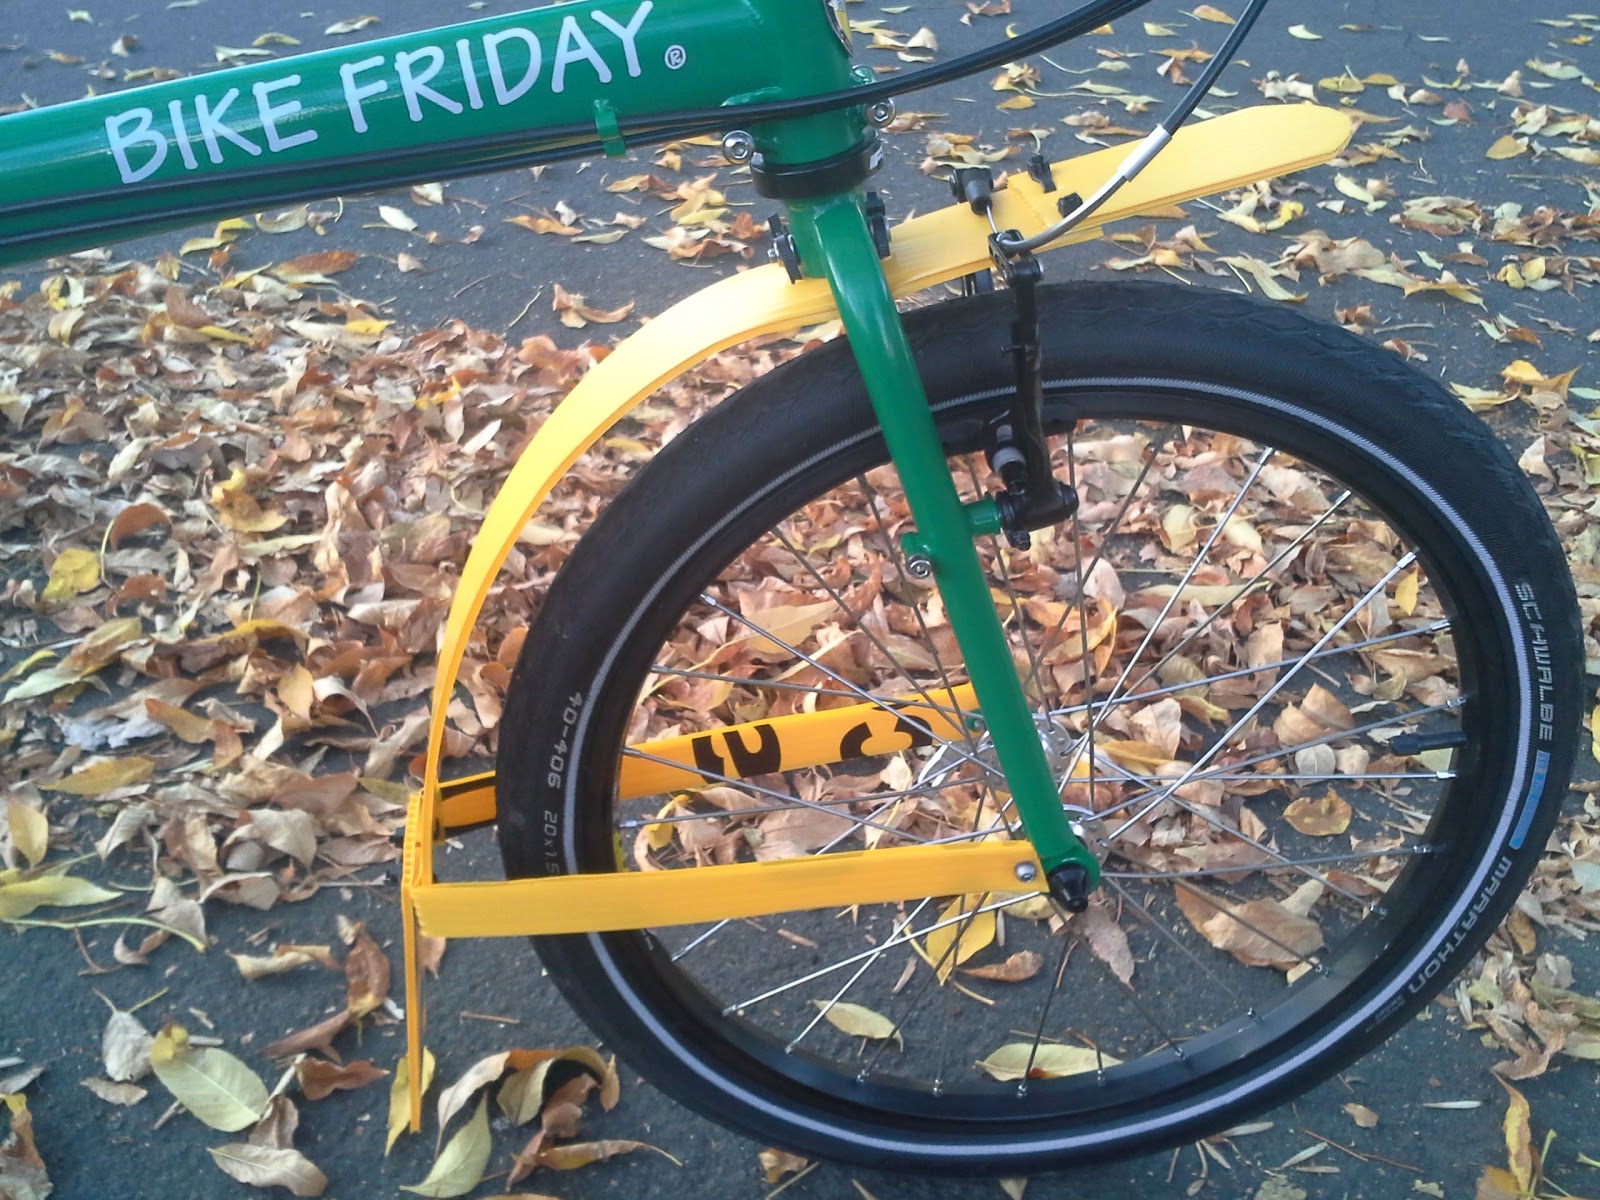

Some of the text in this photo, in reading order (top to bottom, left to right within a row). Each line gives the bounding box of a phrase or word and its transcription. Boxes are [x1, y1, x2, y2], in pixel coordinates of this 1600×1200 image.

[105, 74, 319, 185] BIKE
[339, 0, 654, 134] FRIDAY
[1515, 582, 1554, 741] SCHWALBE
[547, 692, 583, 789] 40-406
[1408, 856, 1512, 994] MARATHON
